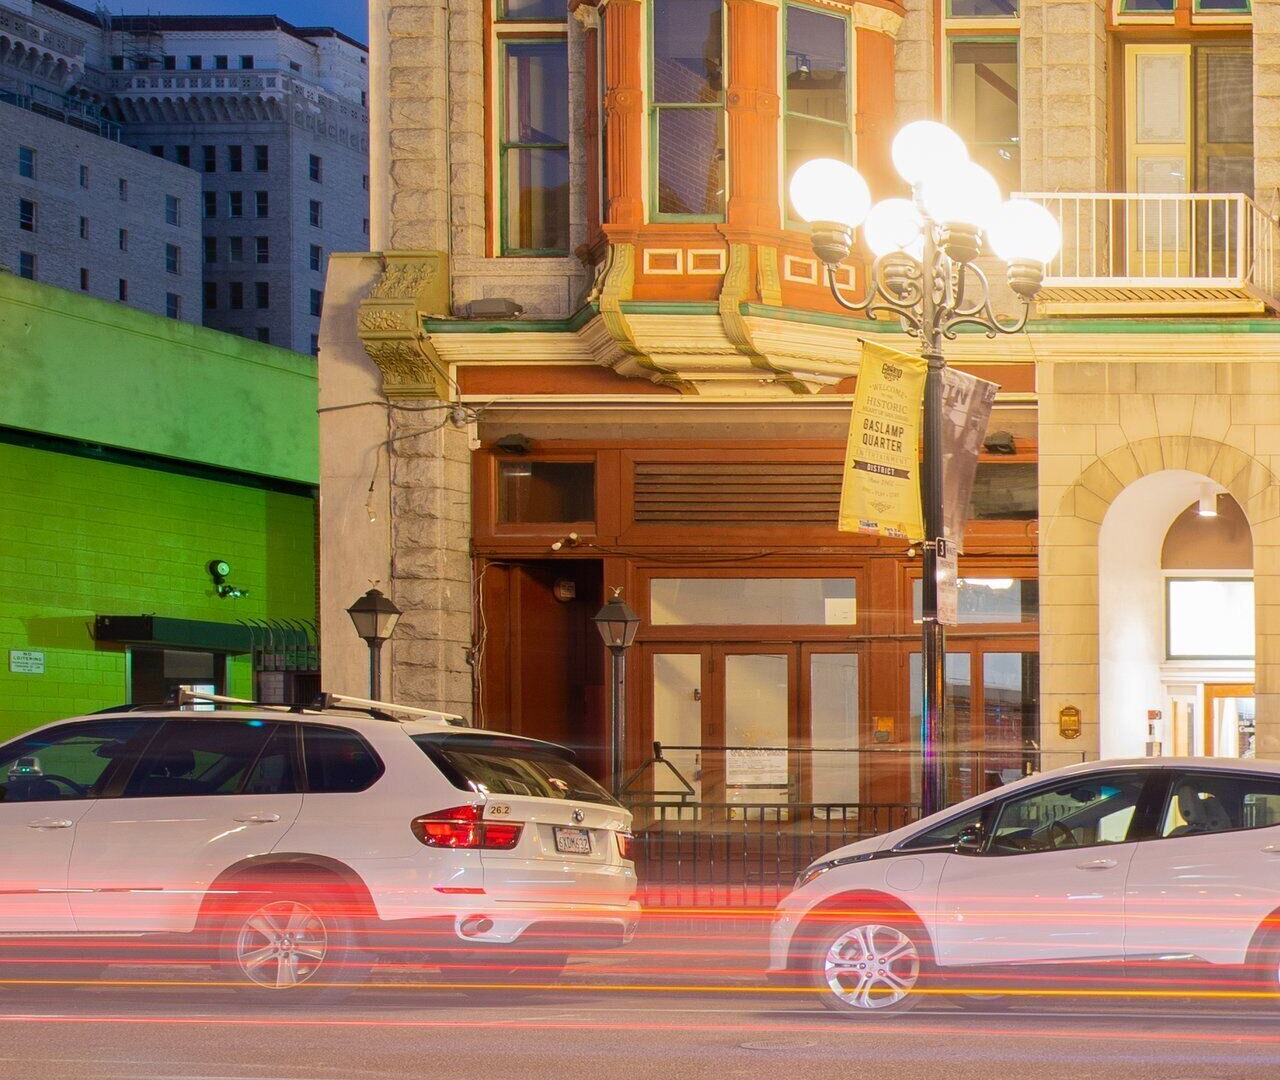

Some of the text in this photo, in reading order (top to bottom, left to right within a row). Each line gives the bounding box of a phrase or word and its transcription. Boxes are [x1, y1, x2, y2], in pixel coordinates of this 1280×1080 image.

[872, 383, 905, 400] WELCOME
[866, 395, 909, 415] HISTORIC
[863, 418, 905, 439] GASLAMP
[862, 432, 903, 453] QUARTER
[866, 463, 895, 476] DISTRICT
[490, 806, 510, 814] 26.2
